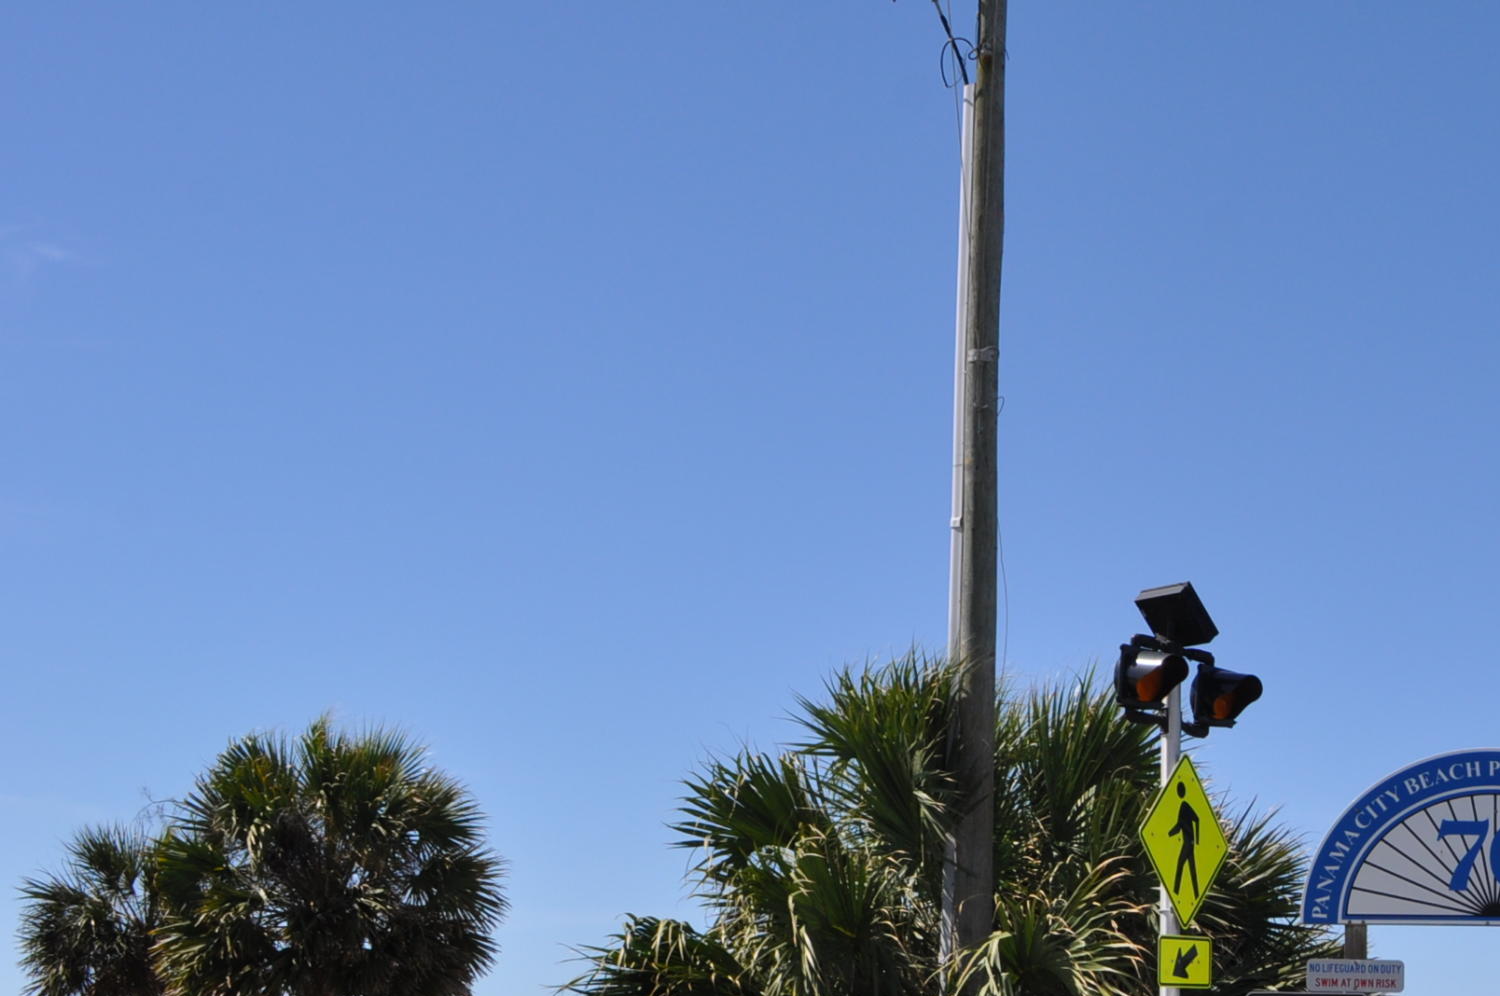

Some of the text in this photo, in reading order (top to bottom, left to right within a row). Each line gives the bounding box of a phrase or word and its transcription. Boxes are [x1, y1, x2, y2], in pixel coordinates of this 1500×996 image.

[1312, 830, 1360, 919] PANAMA
[1354, 786, 1400, 829] CITY
[1404, 761, 1482, 796] BEACH
[1309, 963, 1401, 974] NO LIFEGUARD ON DUTY
[1315, 977, 1396, 988] SWIM AT OWN RISK
